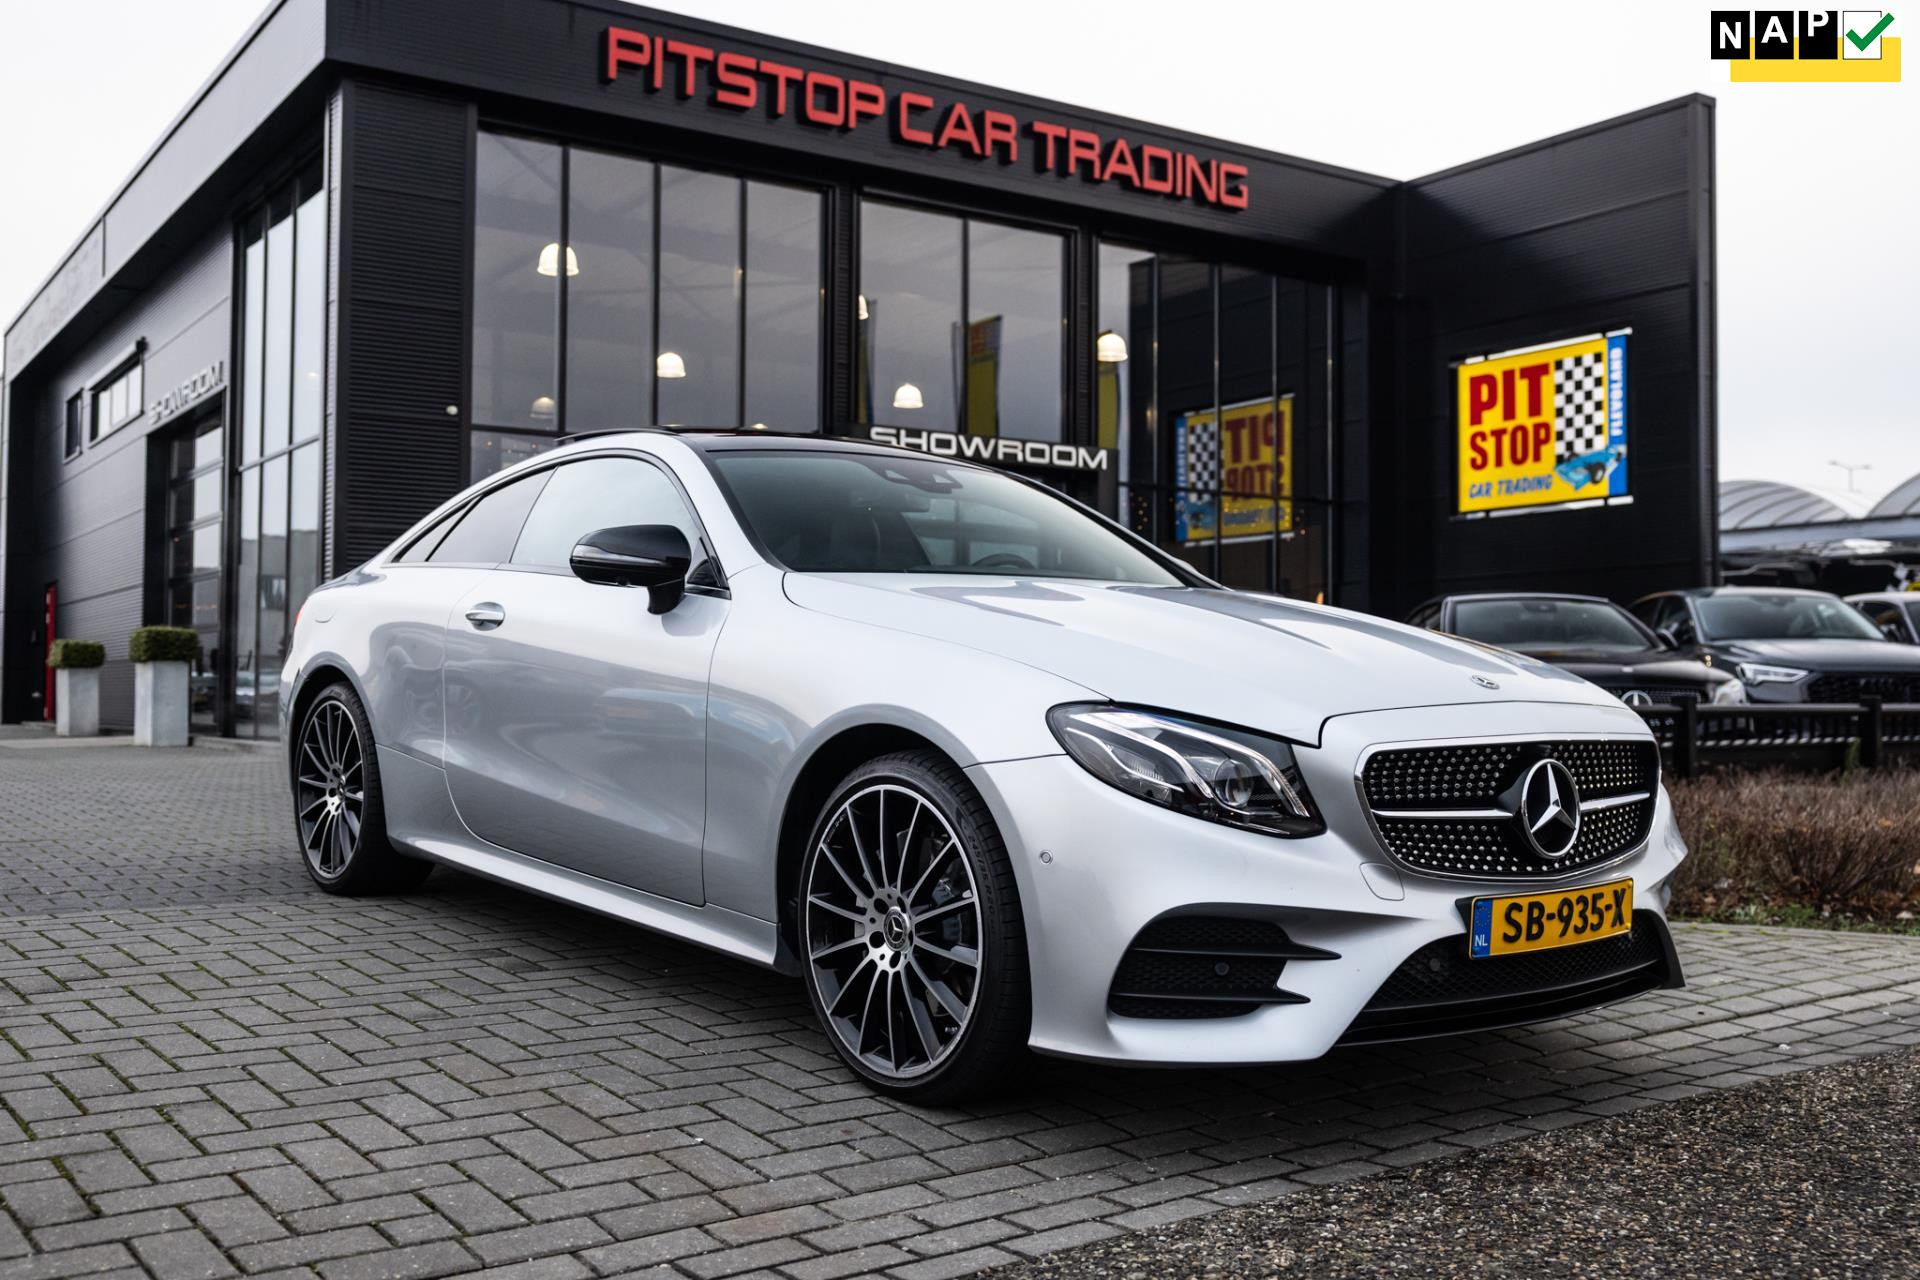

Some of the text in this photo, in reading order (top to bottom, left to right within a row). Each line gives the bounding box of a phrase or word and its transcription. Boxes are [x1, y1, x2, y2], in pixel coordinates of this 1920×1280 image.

[606, 26, 1248, 210] PITSTOP CAR TRADING
[1469, 363, 1550, 426] PIT
[869, 426, 1108, 471] SHOWROOM
[1470, 422, 1551, 471] STOP
[1469, 474, 1553, 498] CAR TRADING
[1502, 887, 1627, 944] SB-935-X
[1474, 934, 1488, 947] NL
